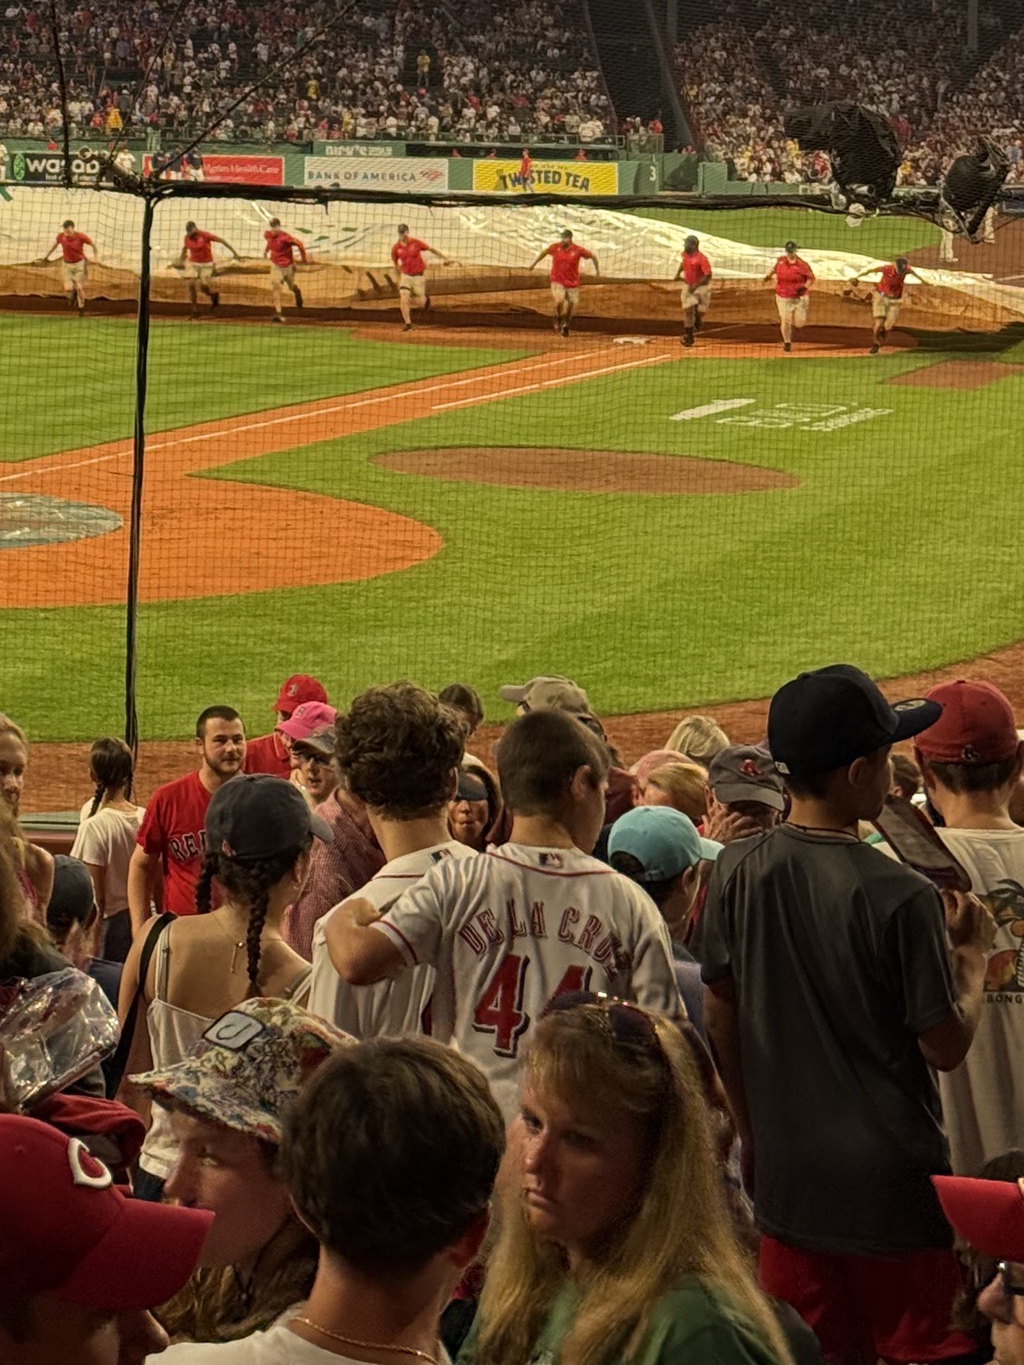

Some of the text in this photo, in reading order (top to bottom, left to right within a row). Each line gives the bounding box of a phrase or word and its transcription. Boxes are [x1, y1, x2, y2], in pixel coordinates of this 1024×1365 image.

[308, 171, 416, 182] BANK OF AMERICA
[565, 172, 590, 192] TEA
[458, 908, 504, 960] DE
[506, 898, 547, 939] LA
[68, 1137, 113, 1189] C
